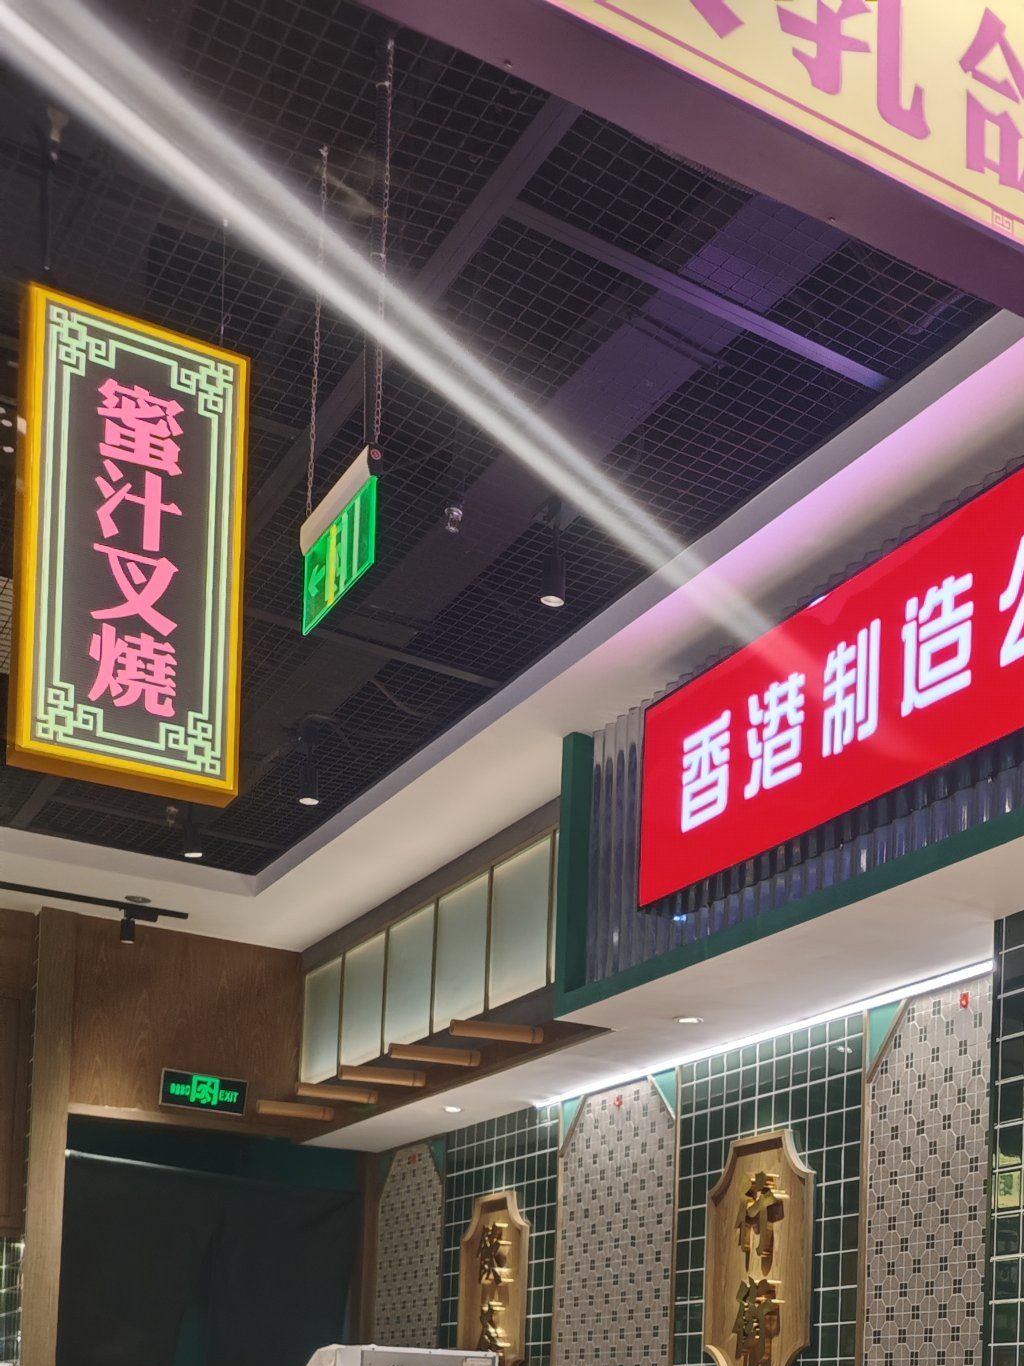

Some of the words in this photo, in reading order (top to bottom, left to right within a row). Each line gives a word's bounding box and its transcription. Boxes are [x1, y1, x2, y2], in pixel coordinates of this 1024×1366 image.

[88, 378, 184, 717] 蜜汁叉燒
[219, 1090, 239, 1103] EXIT
